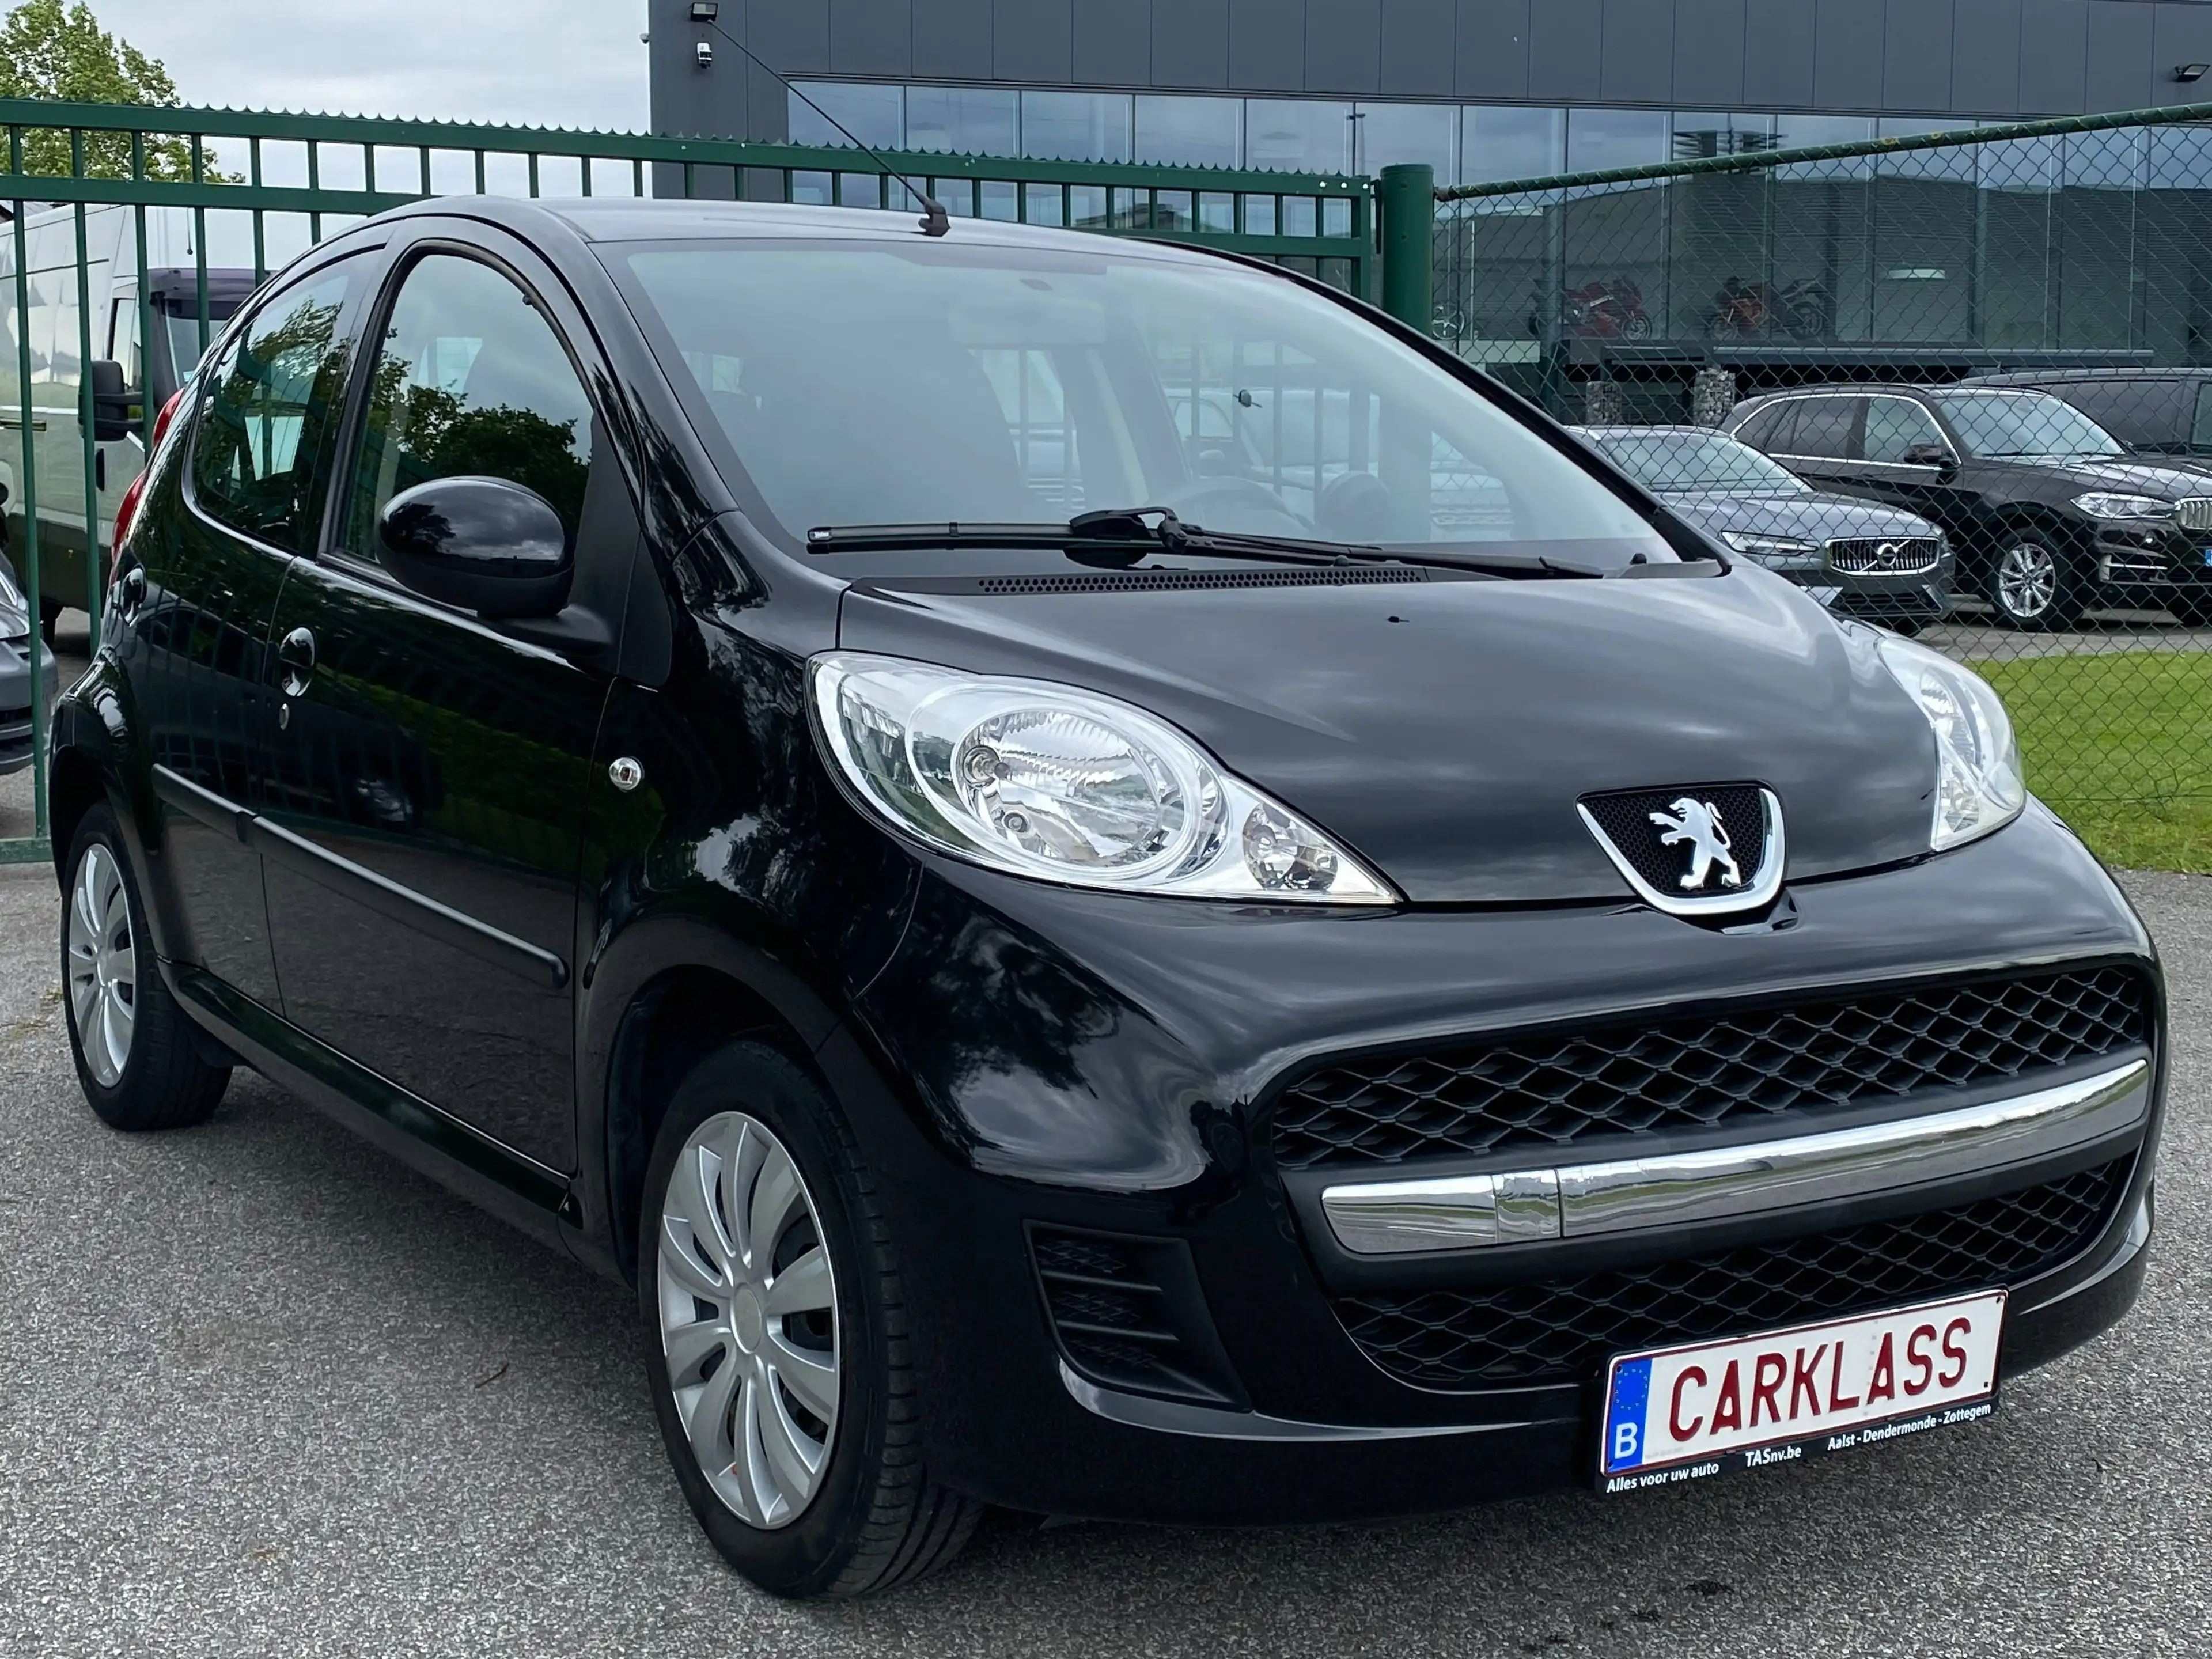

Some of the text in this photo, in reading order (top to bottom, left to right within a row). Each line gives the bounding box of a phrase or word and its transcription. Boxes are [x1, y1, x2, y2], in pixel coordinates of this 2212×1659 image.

[1669, 1317, 1971, 1442] CARKLASS
[1614, 1422, 1638, 1459] B
[1827, 1434, 1856, 1451] Aalst
[1862, 1415, 1937, 1443] Dendermonde
[1943, 1403, 1991, 1425] Zottegem
[1745, 1445, 1802, 1467] TASnv.be
[1606, 1462, 1719, 1493] Alles voor uw auto
